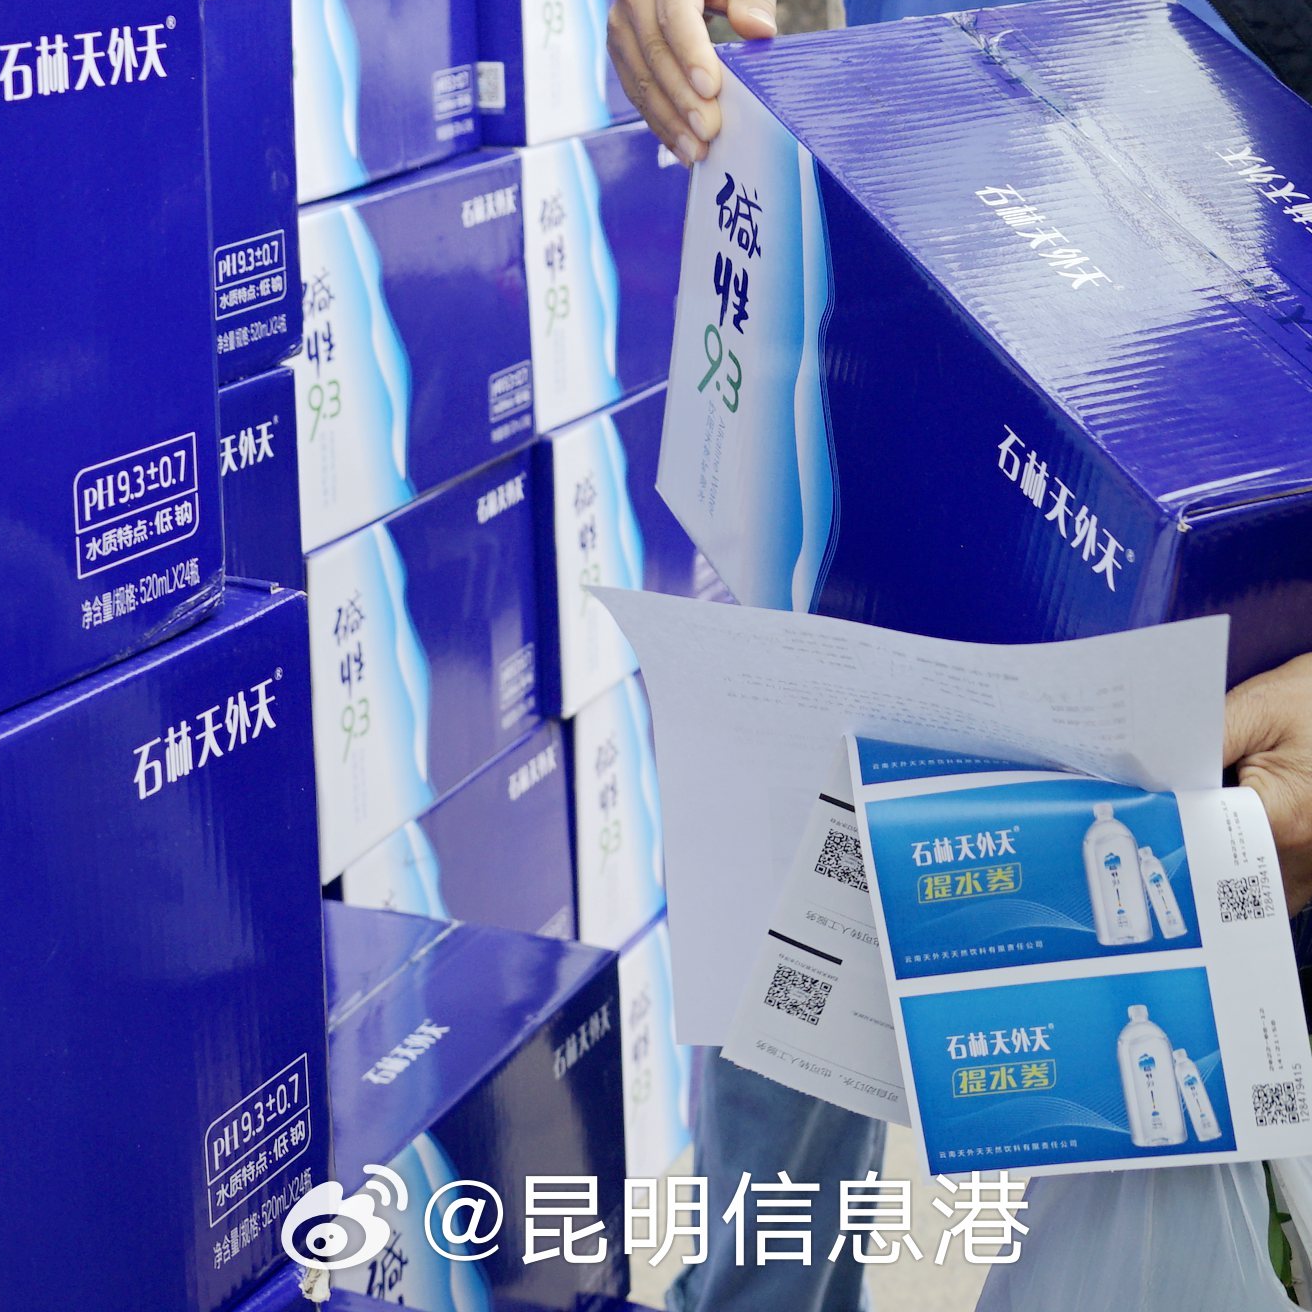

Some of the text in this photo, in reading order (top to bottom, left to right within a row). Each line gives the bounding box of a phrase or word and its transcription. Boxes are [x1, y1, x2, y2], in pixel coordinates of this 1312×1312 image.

[714, 172, 763, 335] 碱性
[974, 183, 1113, 291] 石林天外天
[697, 323, 742, 414] 9.3
[308, 379, 341, 443] 9.3
[997, 424, 1122, 592] 石林天外天
[133, 678, 277, 801] 石林天外天
[341, 697, 370, 764] 9.3
[911, 829, 1016, 867] 石林天外天
[924, 866, 1015, 901] 提水券
[1256, 856, 1275, 918] 128479414
[904, 940, 1044, 964] 云南天外天天然饮料有限责任公司
[945, 1027, 1051, 1060] 石林天外天
[958, 1062, 1050, 1095] 提水券
[1291, 1063, 1310, 1123] 128479415
[939, 1139, 1078, 1159] 云南天外天天然饮料有限责任公司
[366, 1231, 409, 1306] 碱
